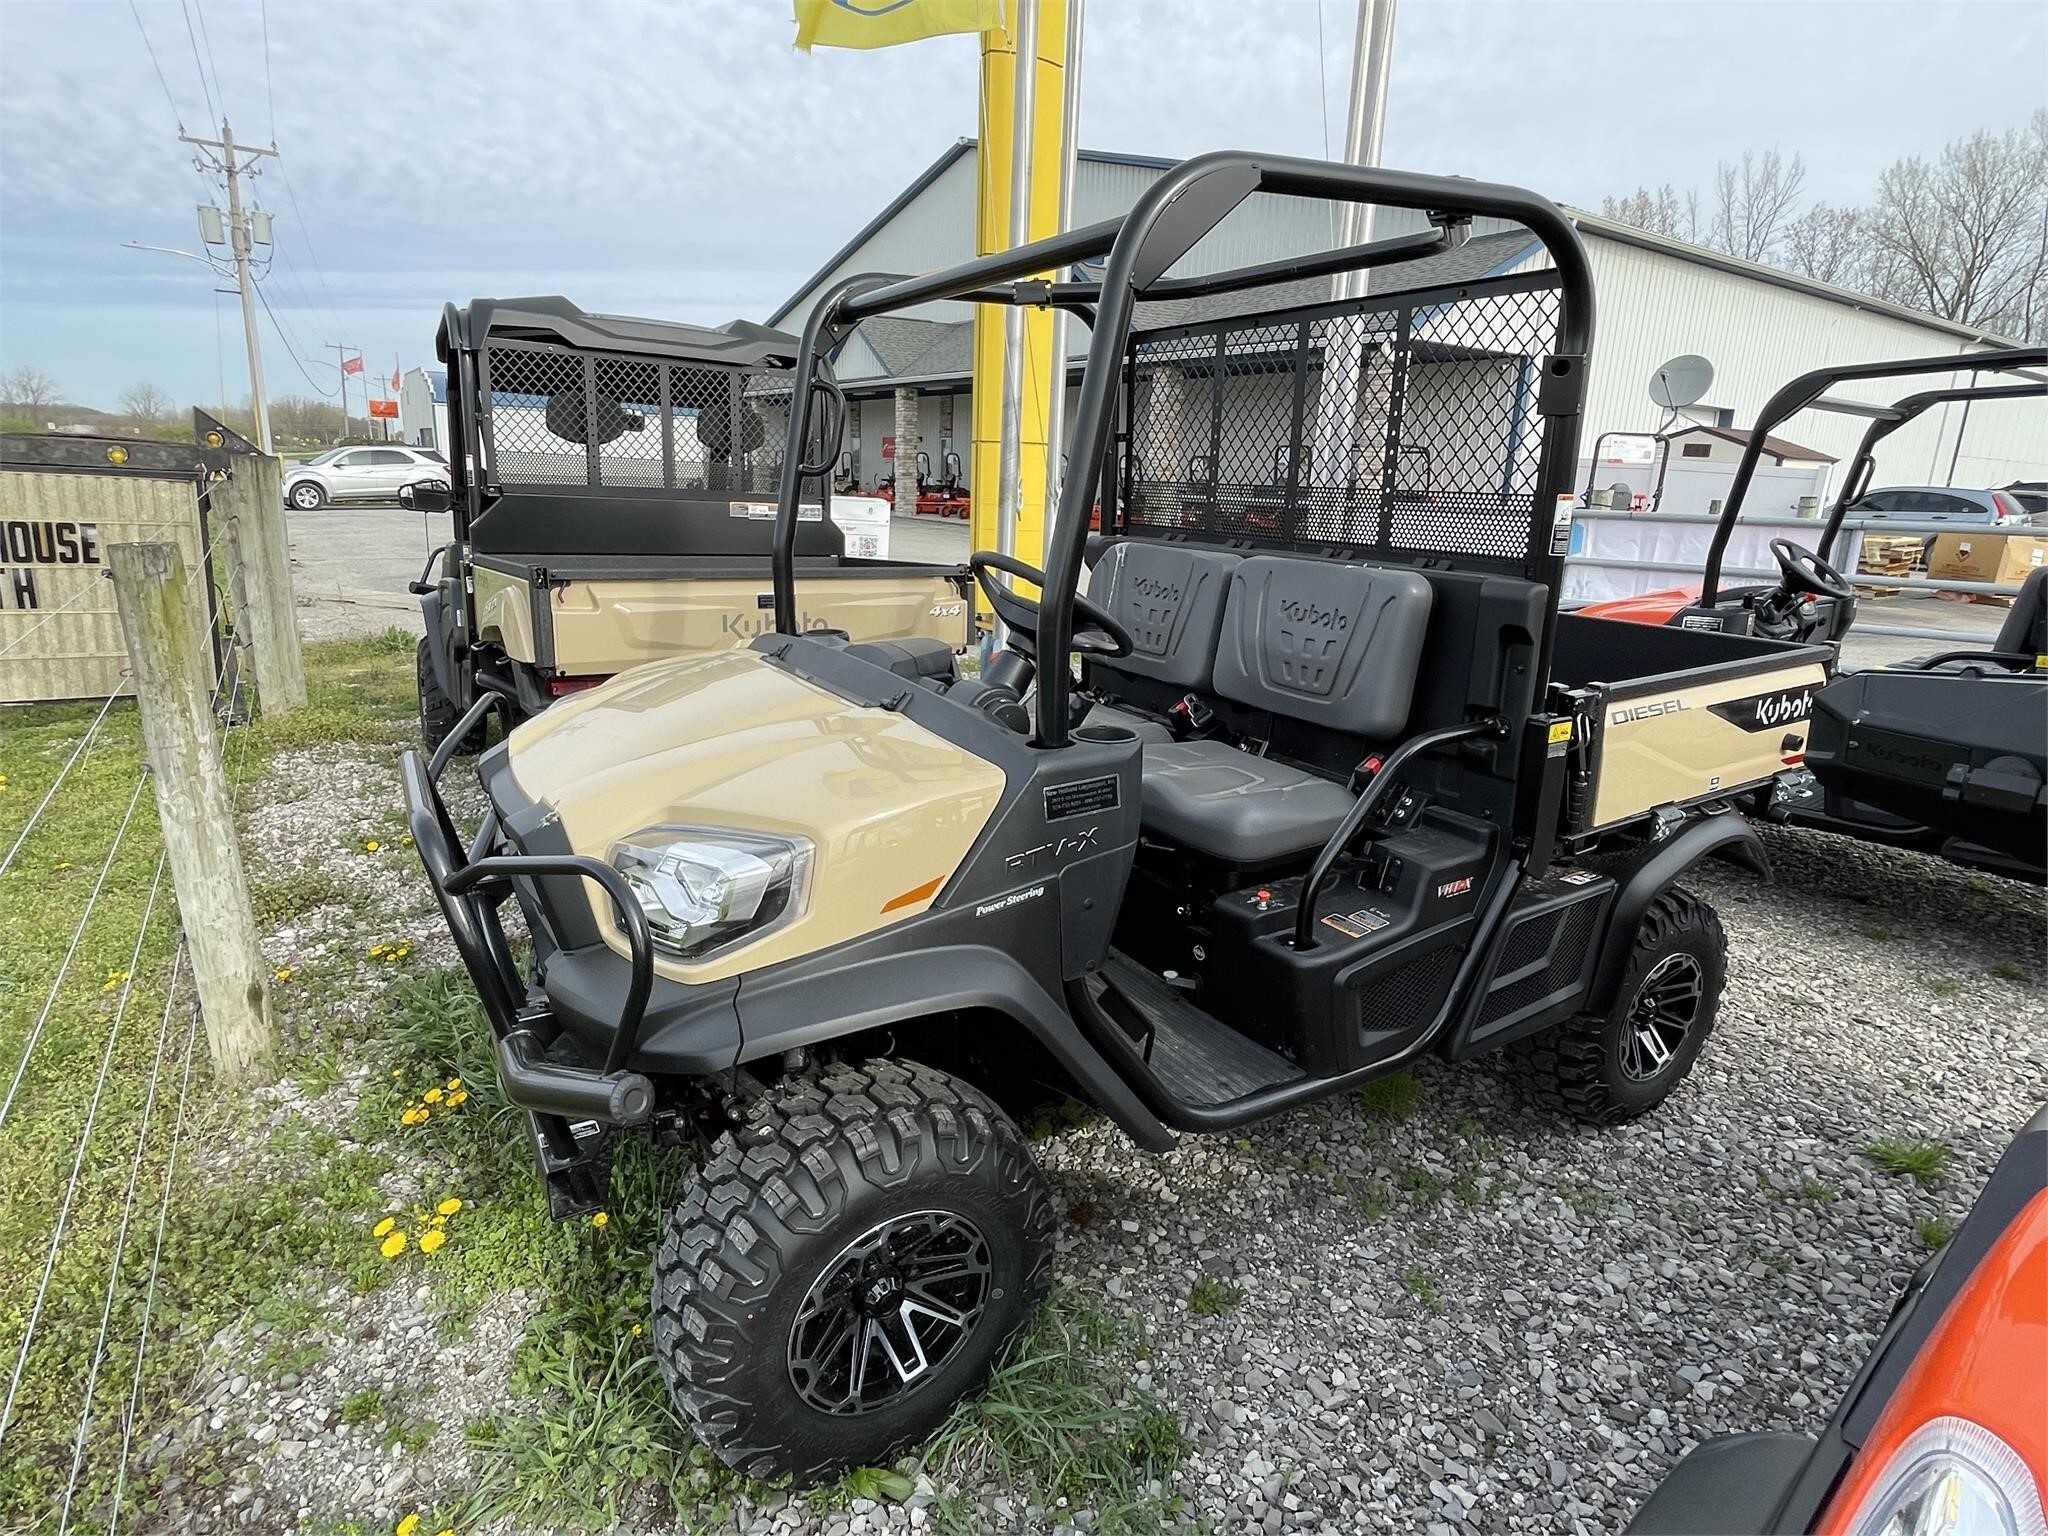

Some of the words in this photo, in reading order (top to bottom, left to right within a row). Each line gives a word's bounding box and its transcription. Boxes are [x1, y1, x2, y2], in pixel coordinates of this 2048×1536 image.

[929, 604, 961, 617] 4x4
[1281, 599, 1347, 631] Kubota
[1611, 699, 1691, 725] DIESEL
[976, 900, 1006, 917] Power
[1006, 886, 1045, 906] Steering
